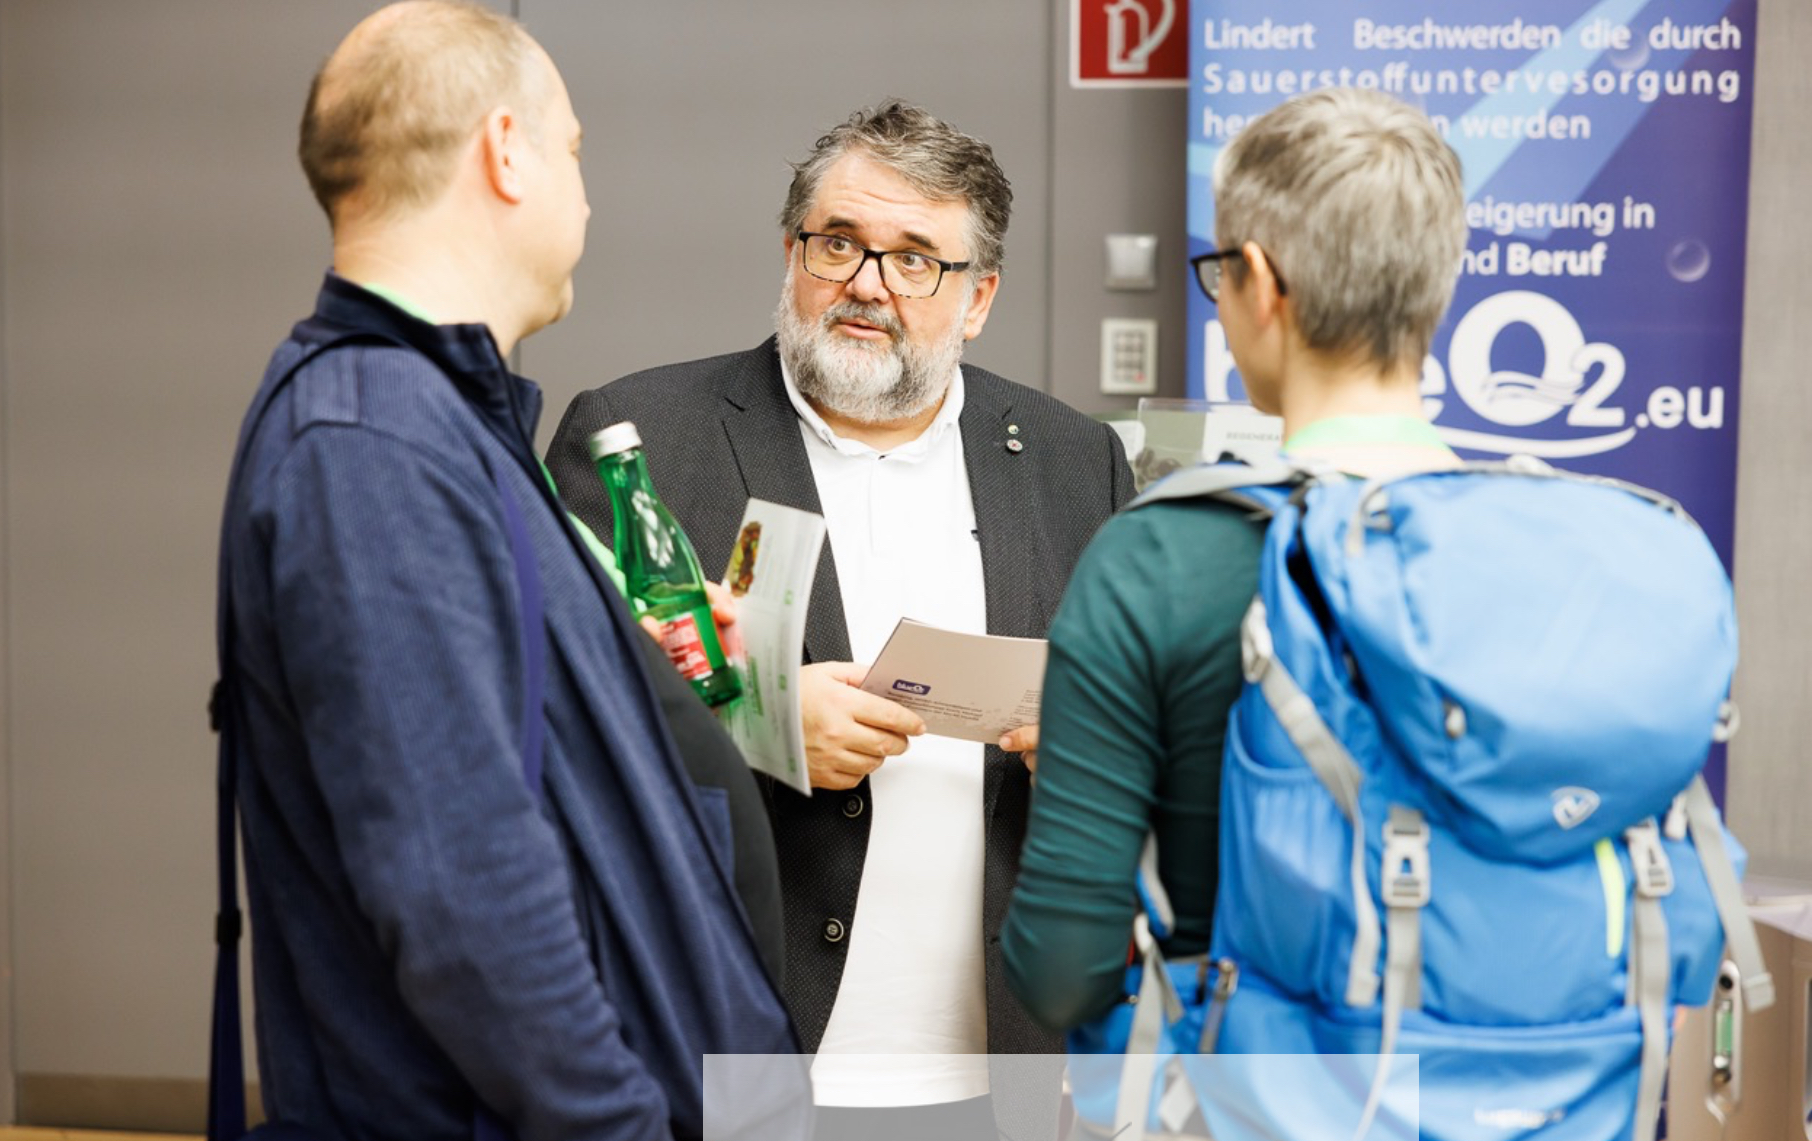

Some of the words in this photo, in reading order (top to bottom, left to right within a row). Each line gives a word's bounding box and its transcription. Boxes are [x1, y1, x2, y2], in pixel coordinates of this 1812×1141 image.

[1204, 17, 1315, 49] Lindert
[1353, 17, 1561, 49] Beschwerden
[1580, 17, 1632, 49] die
[1649, 16, 1741, 49] durch
[1203, 60, 1740, 102] Sauerstoffuntervesorgung
[1461, 107, 1592, 139] werden
[1466, 196, 1615, 236] eigerung
[1622, 196, 1655, 229] in
[1458, 241, 1499, 275] nd
[1506, 241, 1608, 276] Beruf
